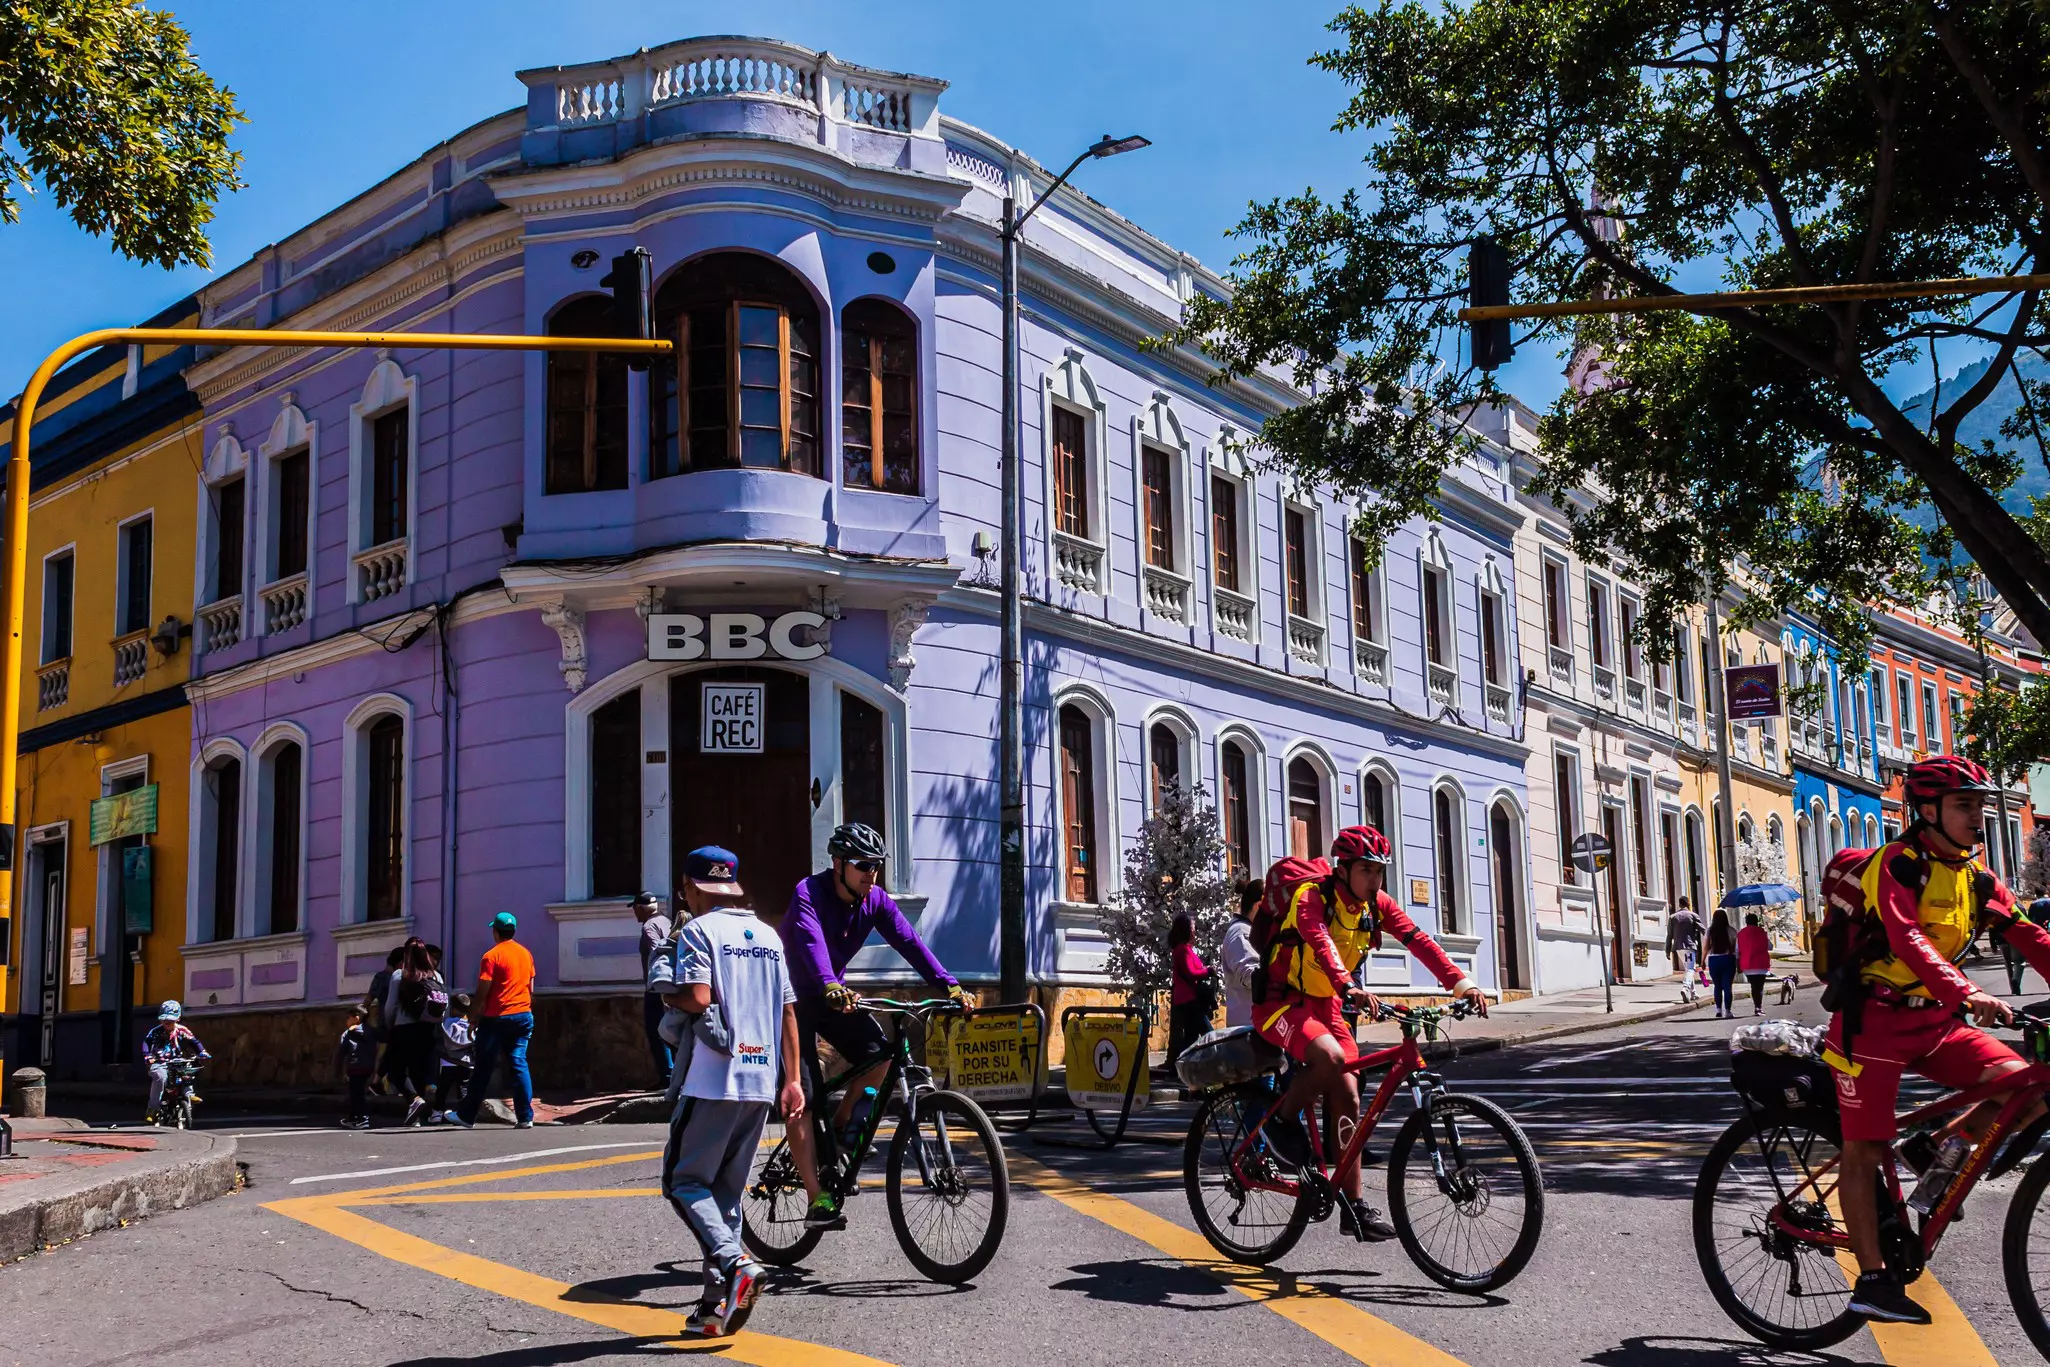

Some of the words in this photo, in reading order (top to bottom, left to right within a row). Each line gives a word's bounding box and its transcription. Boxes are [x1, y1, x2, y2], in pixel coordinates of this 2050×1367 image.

[648, 612, 826, 660] BBC
[711, 691, 754, 716] CAFÉ
[711, 719, 755, 749] REC
[738, 1043, 764, 1055] Super
[956, 1039, 1017, 1056] TRANSITE
[742, 1055, 769, 1066] INTER
[964, 1056, 990, 1071] POR
[993, 1055, 1010, 1068] SU
[957, 1071, 1019, 1086] DERECHA
